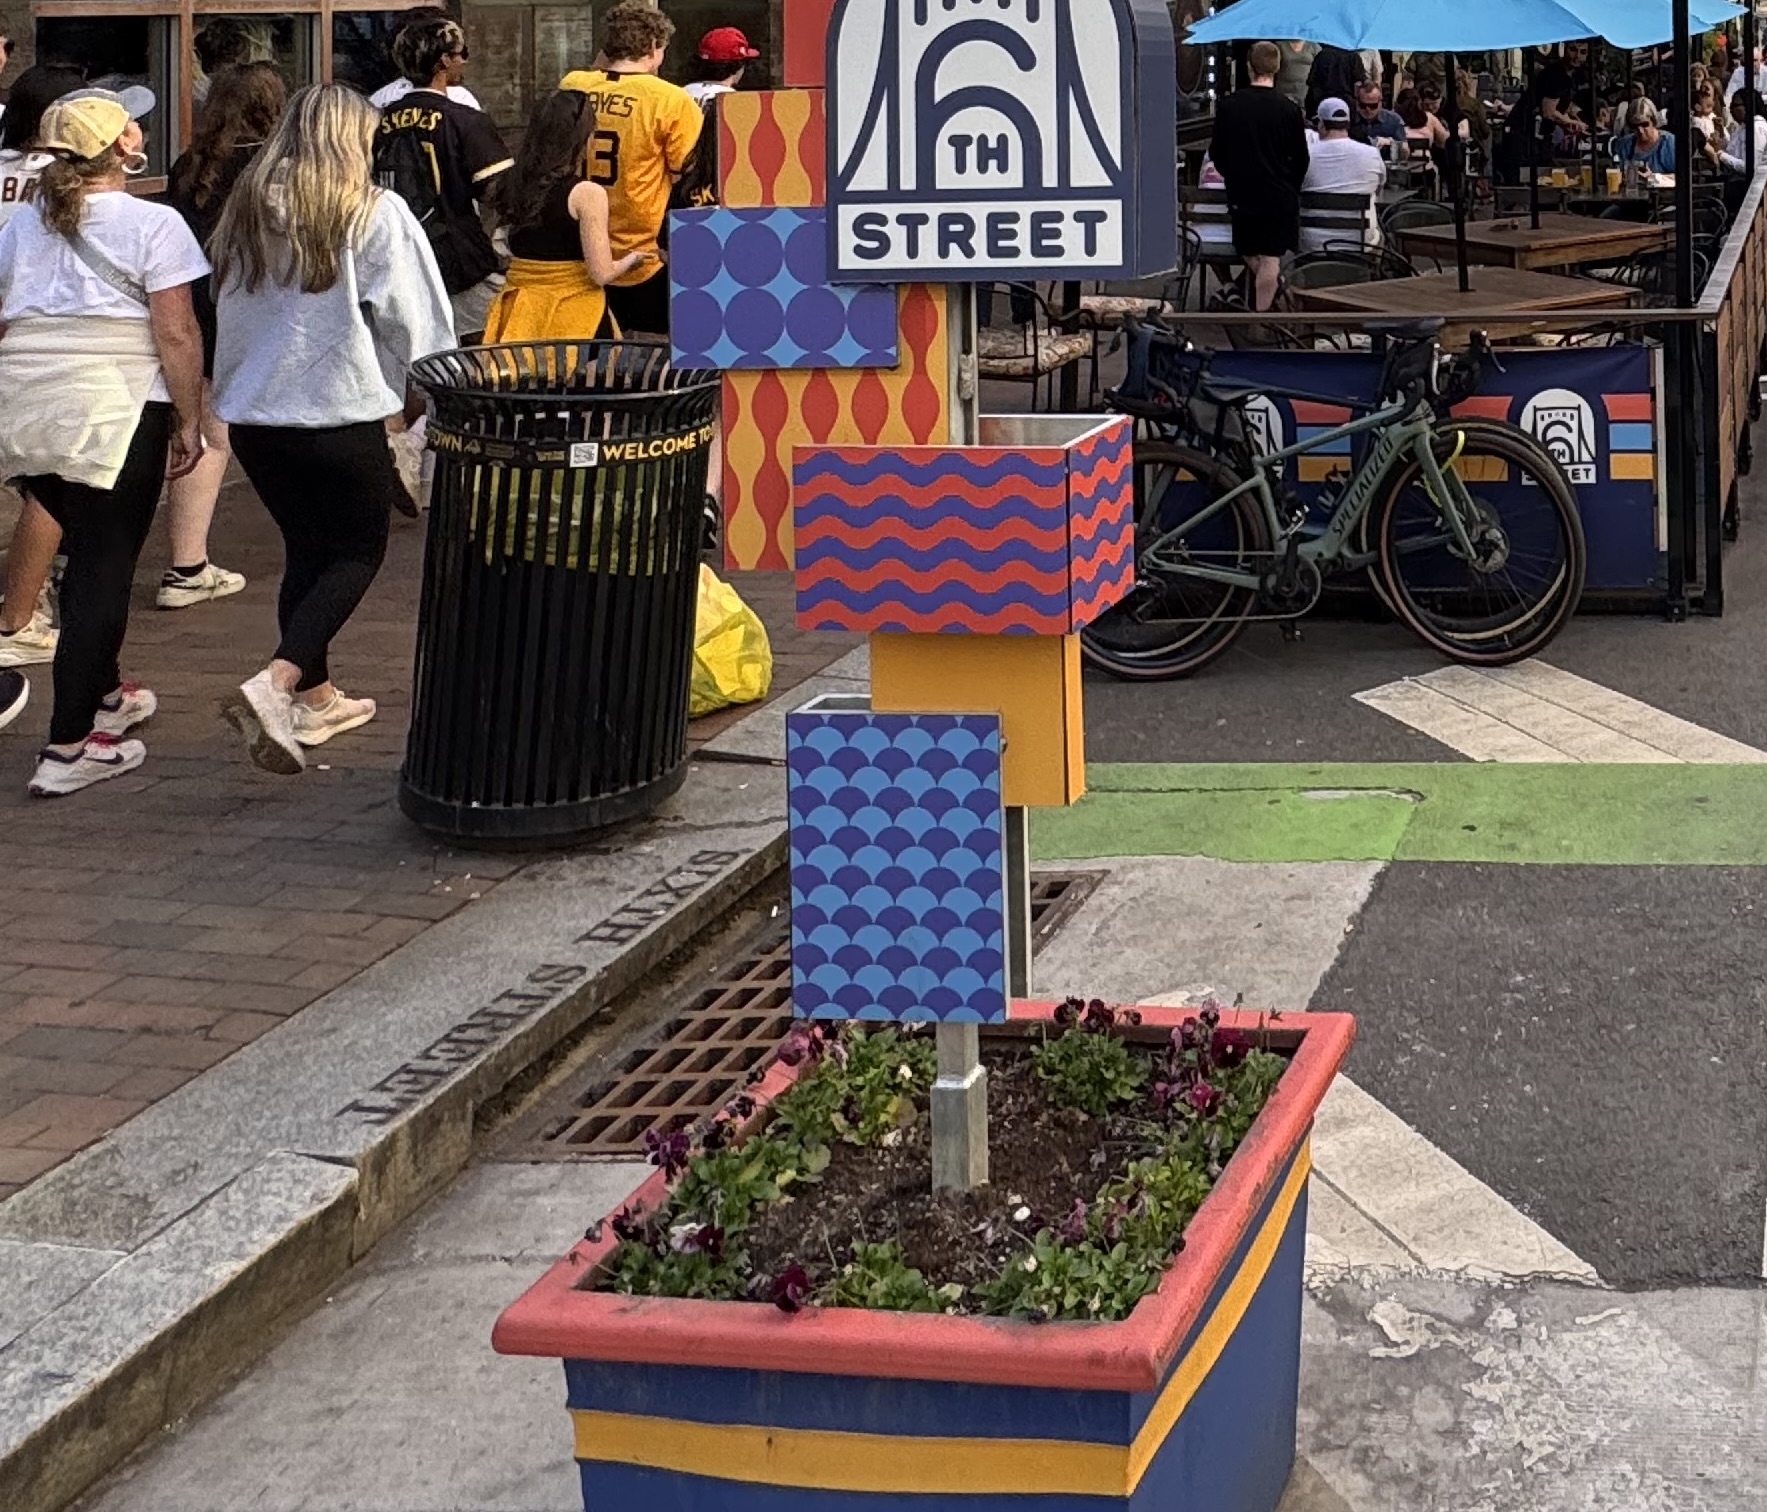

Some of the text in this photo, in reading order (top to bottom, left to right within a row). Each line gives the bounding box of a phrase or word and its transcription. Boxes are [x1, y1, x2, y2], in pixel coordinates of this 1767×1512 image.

[588, 91, 638, 118] AYES
[851, 210, 1109, 261] STREET
[602, 431, 697, 461] WELCOME
[1332, 437, 1394, 537] SPECIALIZED
[574, 849, 740, 947] SIXTH
[333, 963, 588, 1125] STREET
